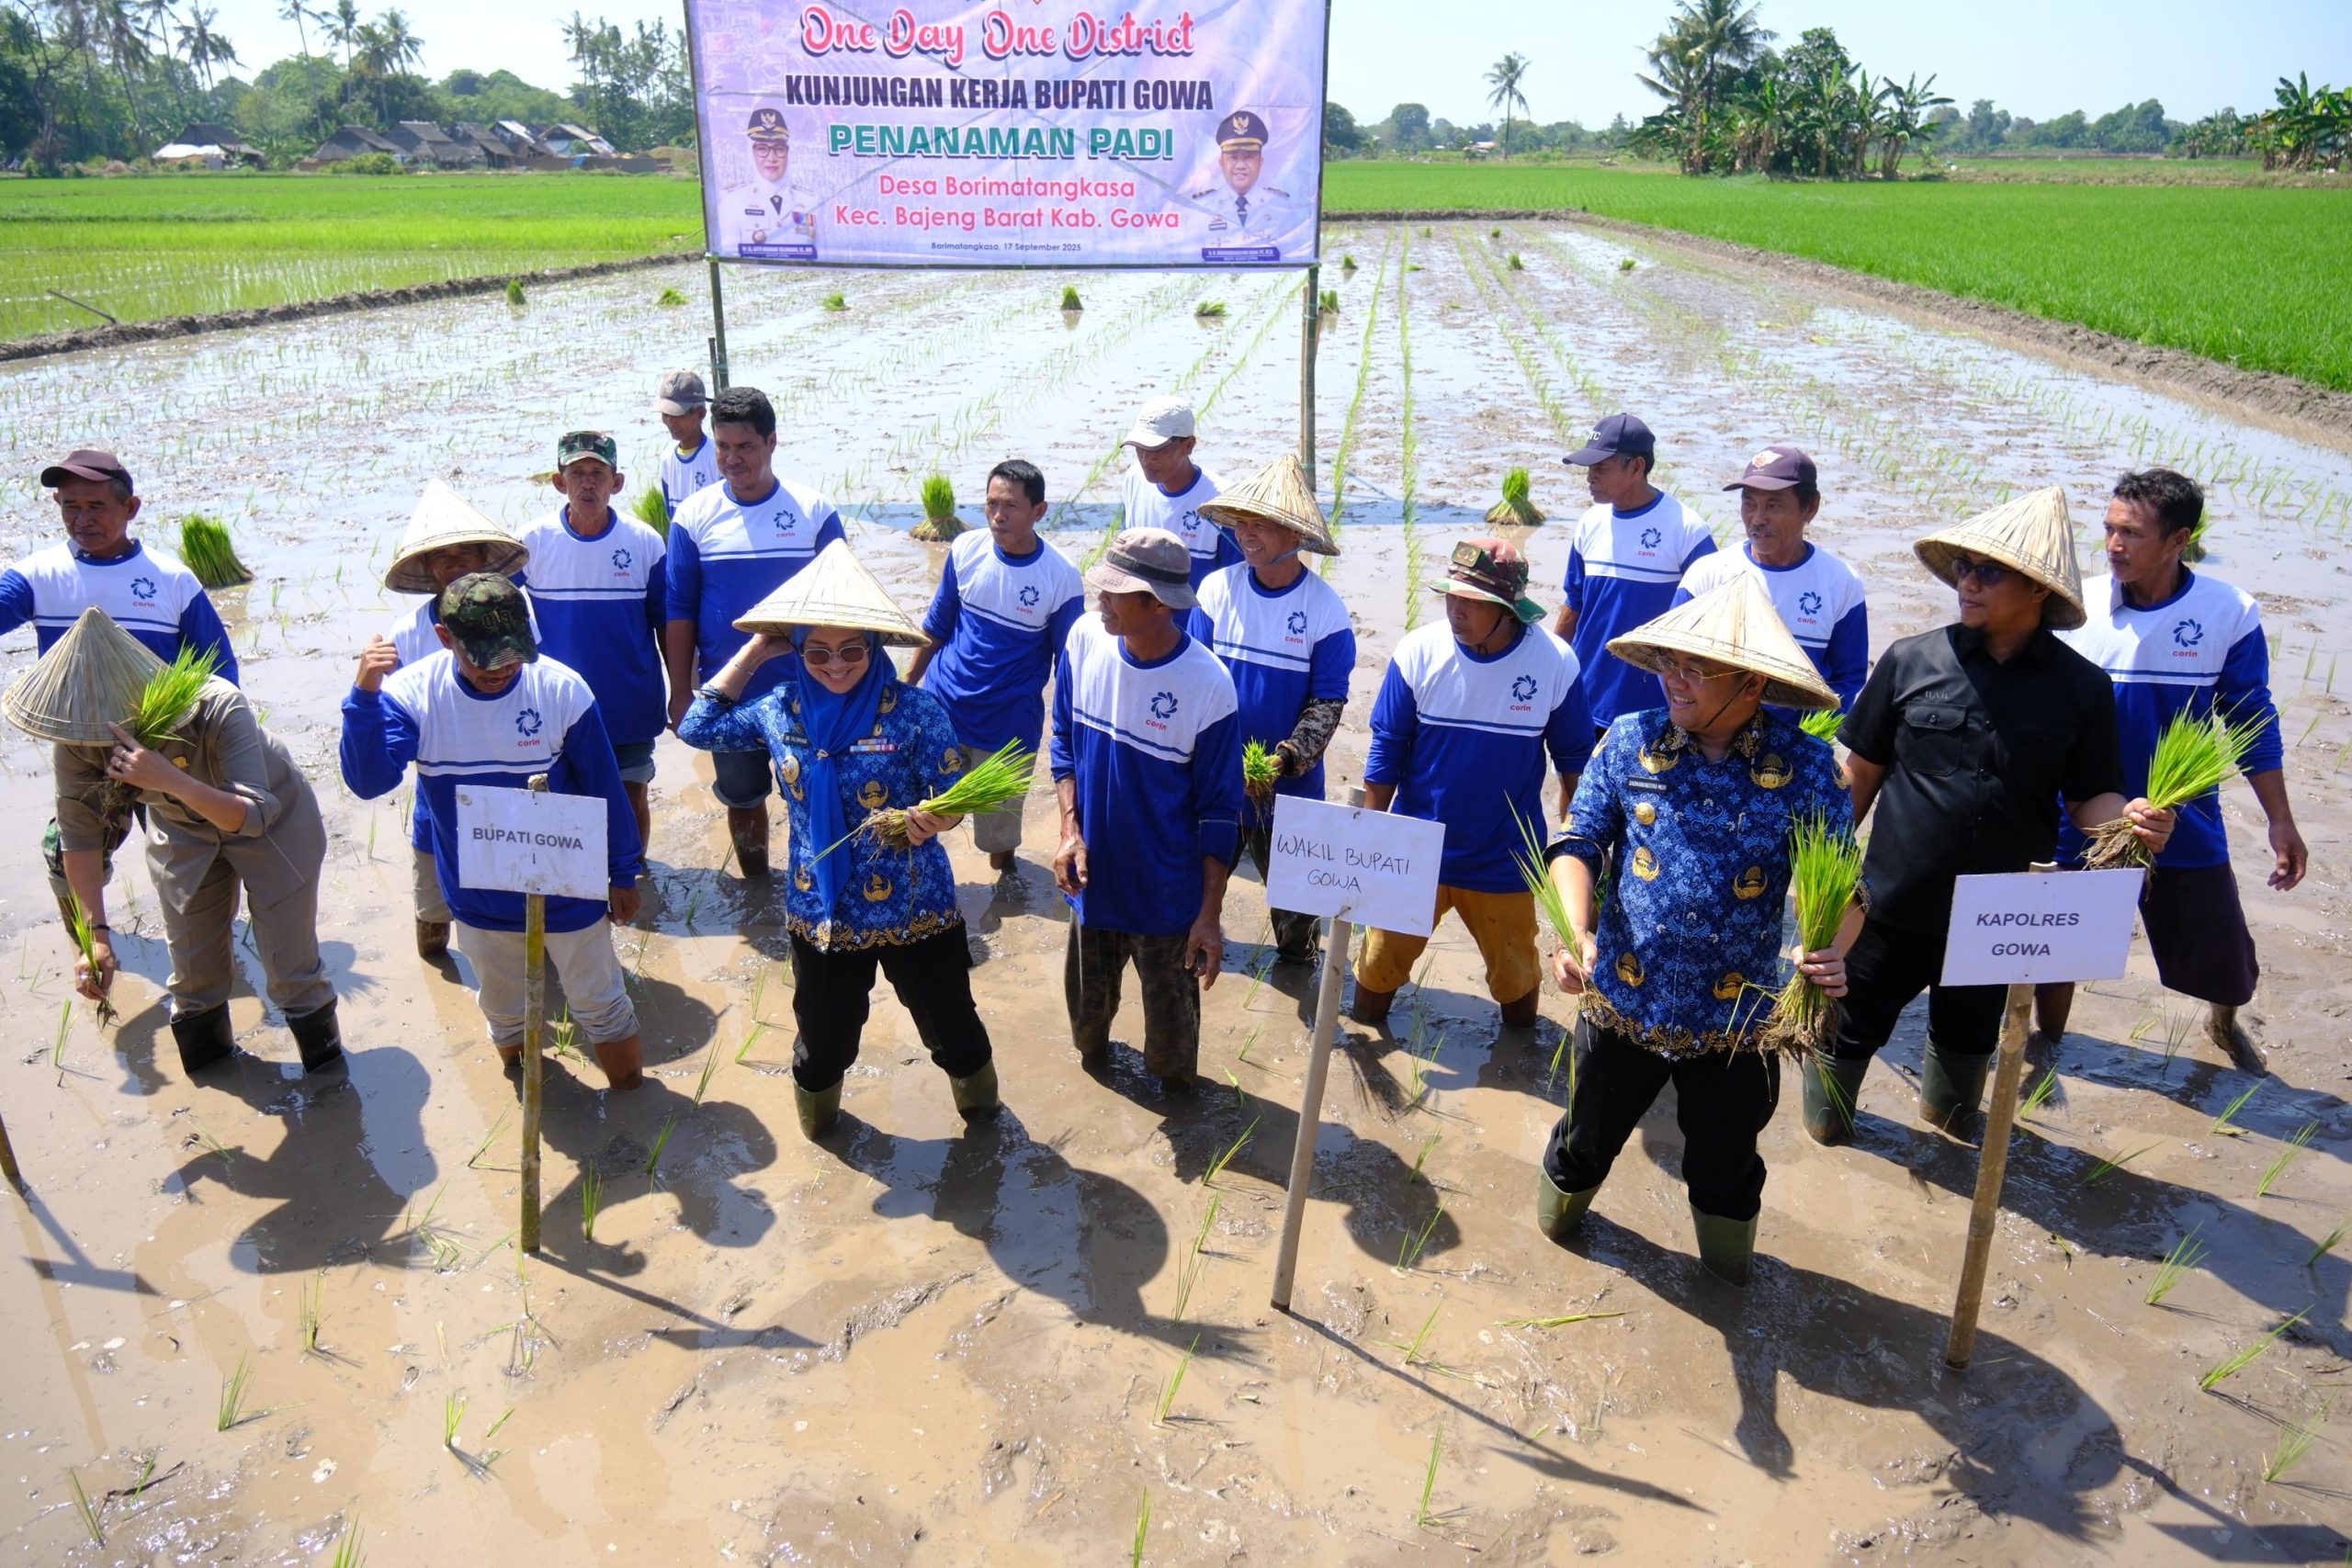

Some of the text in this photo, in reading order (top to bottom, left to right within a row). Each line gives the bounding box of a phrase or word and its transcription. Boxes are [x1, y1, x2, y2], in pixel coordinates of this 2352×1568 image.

[800, 6, 1194, 70] One Day One District
[786, 75, 1214, 109] KUNJUNGAN KERJA BUPATI GOWA
[829, 124, 1174, 160] PENANAMAN PADI
[879, 175, 1136, 202] Desa Borimatangkasa
[835, 206, 1180, 231] Kec. Bajeng Barat Kab. Gowa
[1003, 243, 1013, 251] 17
[1015, 243, 1060, 252] September
[1062, 243, 1082, 252] 2025
[1797, 617, 1817, 626] corin
[1284, 636, 1304, 645] corin
[2172, 649, 2198, 658] corin
[1510, 704, 1532, 712] corin
[1145, 719, 1168, 731] corin
[517, 739, 540, 747] corin
[472, 828, 583, 850] BUPATI GOWA
[1277, 834, 1409, 874] WAKIL BUPATI
[1307, 869, 1362, 893] GOWA
[1976, 912, 2080, 927] KAPOLRES
[1991, 943, 2051, 956] GOWA
